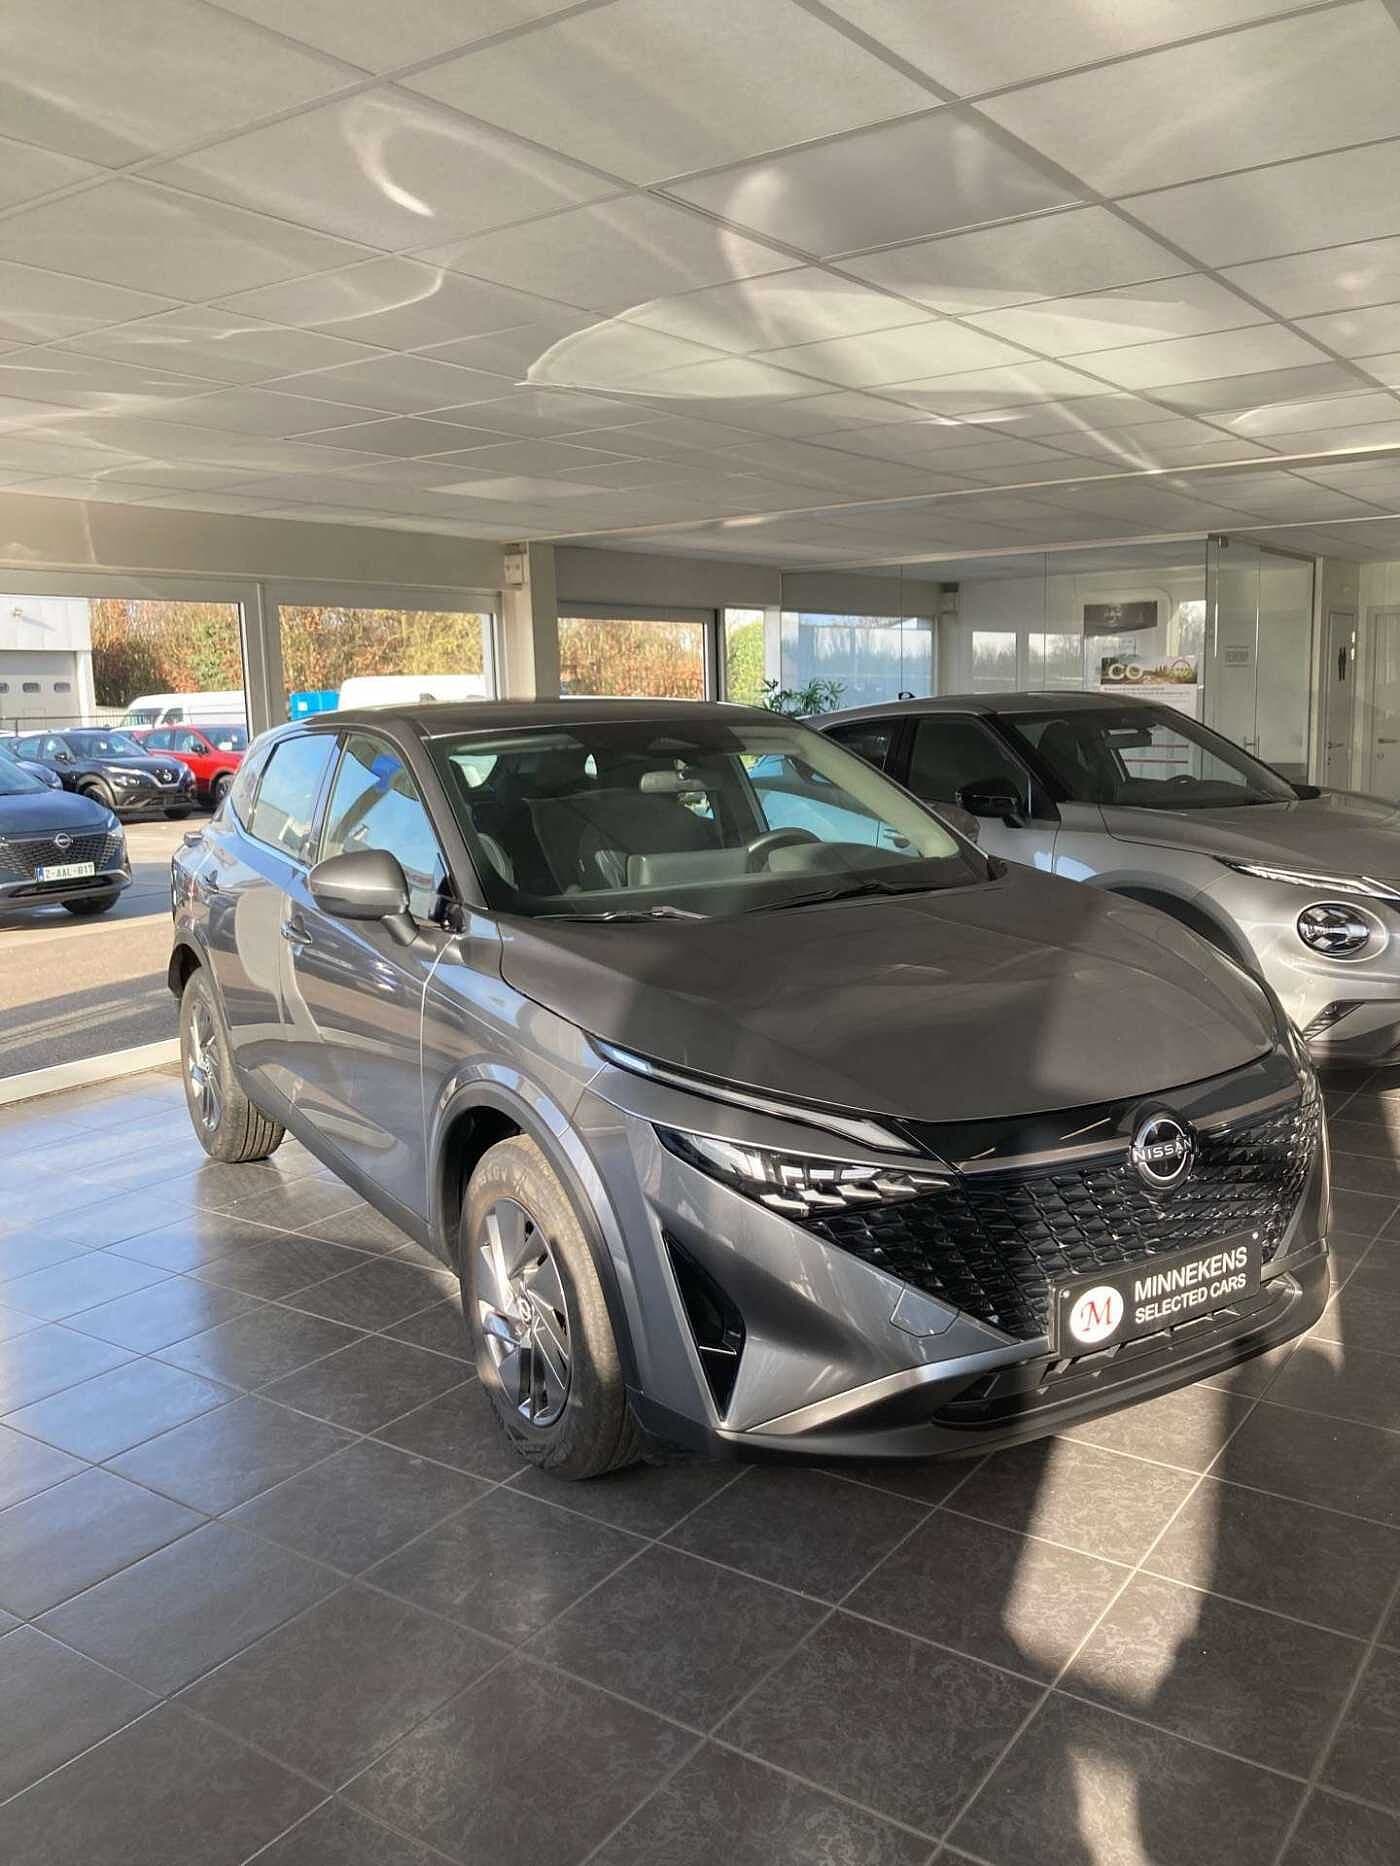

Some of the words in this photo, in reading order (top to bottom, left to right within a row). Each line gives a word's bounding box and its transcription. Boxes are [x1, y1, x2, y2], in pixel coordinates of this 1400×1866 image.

[1132, 1137, 1192, 1163] NISSAN
[1134, 1246, 1248, 1302] MINNEKENS
[1081, 1296, 1113, 1332] M
[1135, 1289, 1208, 1324] SELECTED
[1210, 1272, 1247, 1298] CARS
